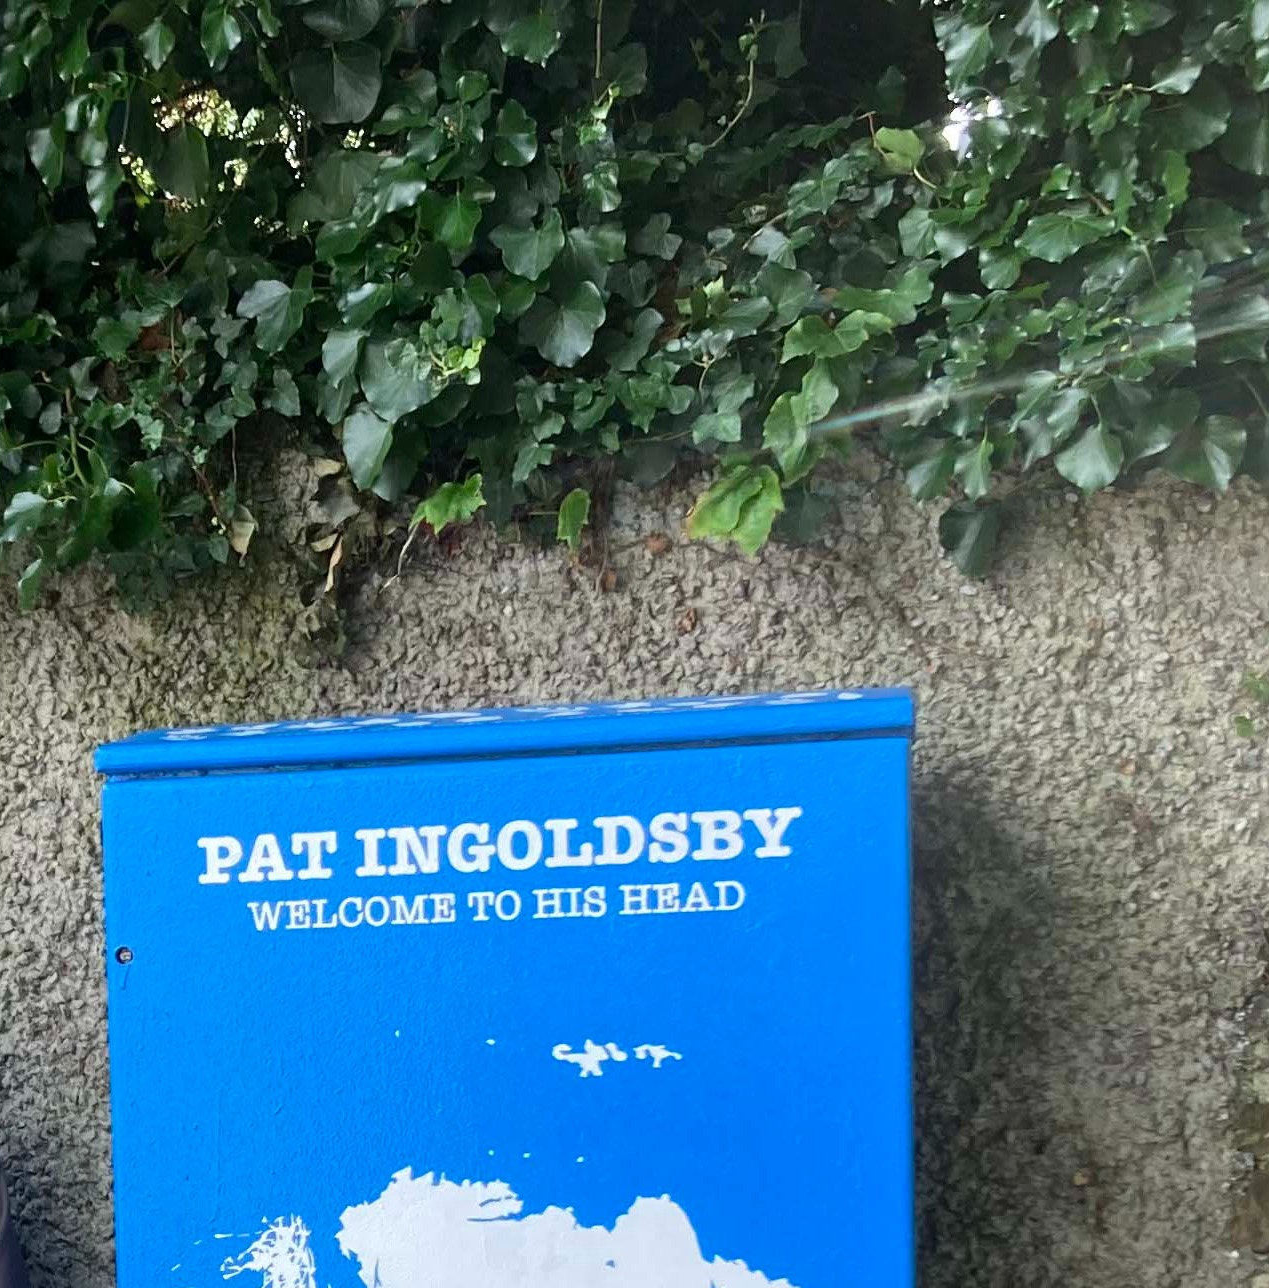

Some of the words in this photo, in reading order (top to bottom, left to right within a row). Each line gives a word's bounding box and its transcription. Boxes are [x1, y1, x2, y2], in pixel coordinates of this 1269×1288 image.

[197, 831, 338, 885] PAT
[354, 806, 803, 877] INGOLDSBY
[247, 892, 456, 931] WELCOME
[467, 890, 522, 921] TO
[532, 885, 608, 919] HIS
[619, 880, 746, 915] HEAD
